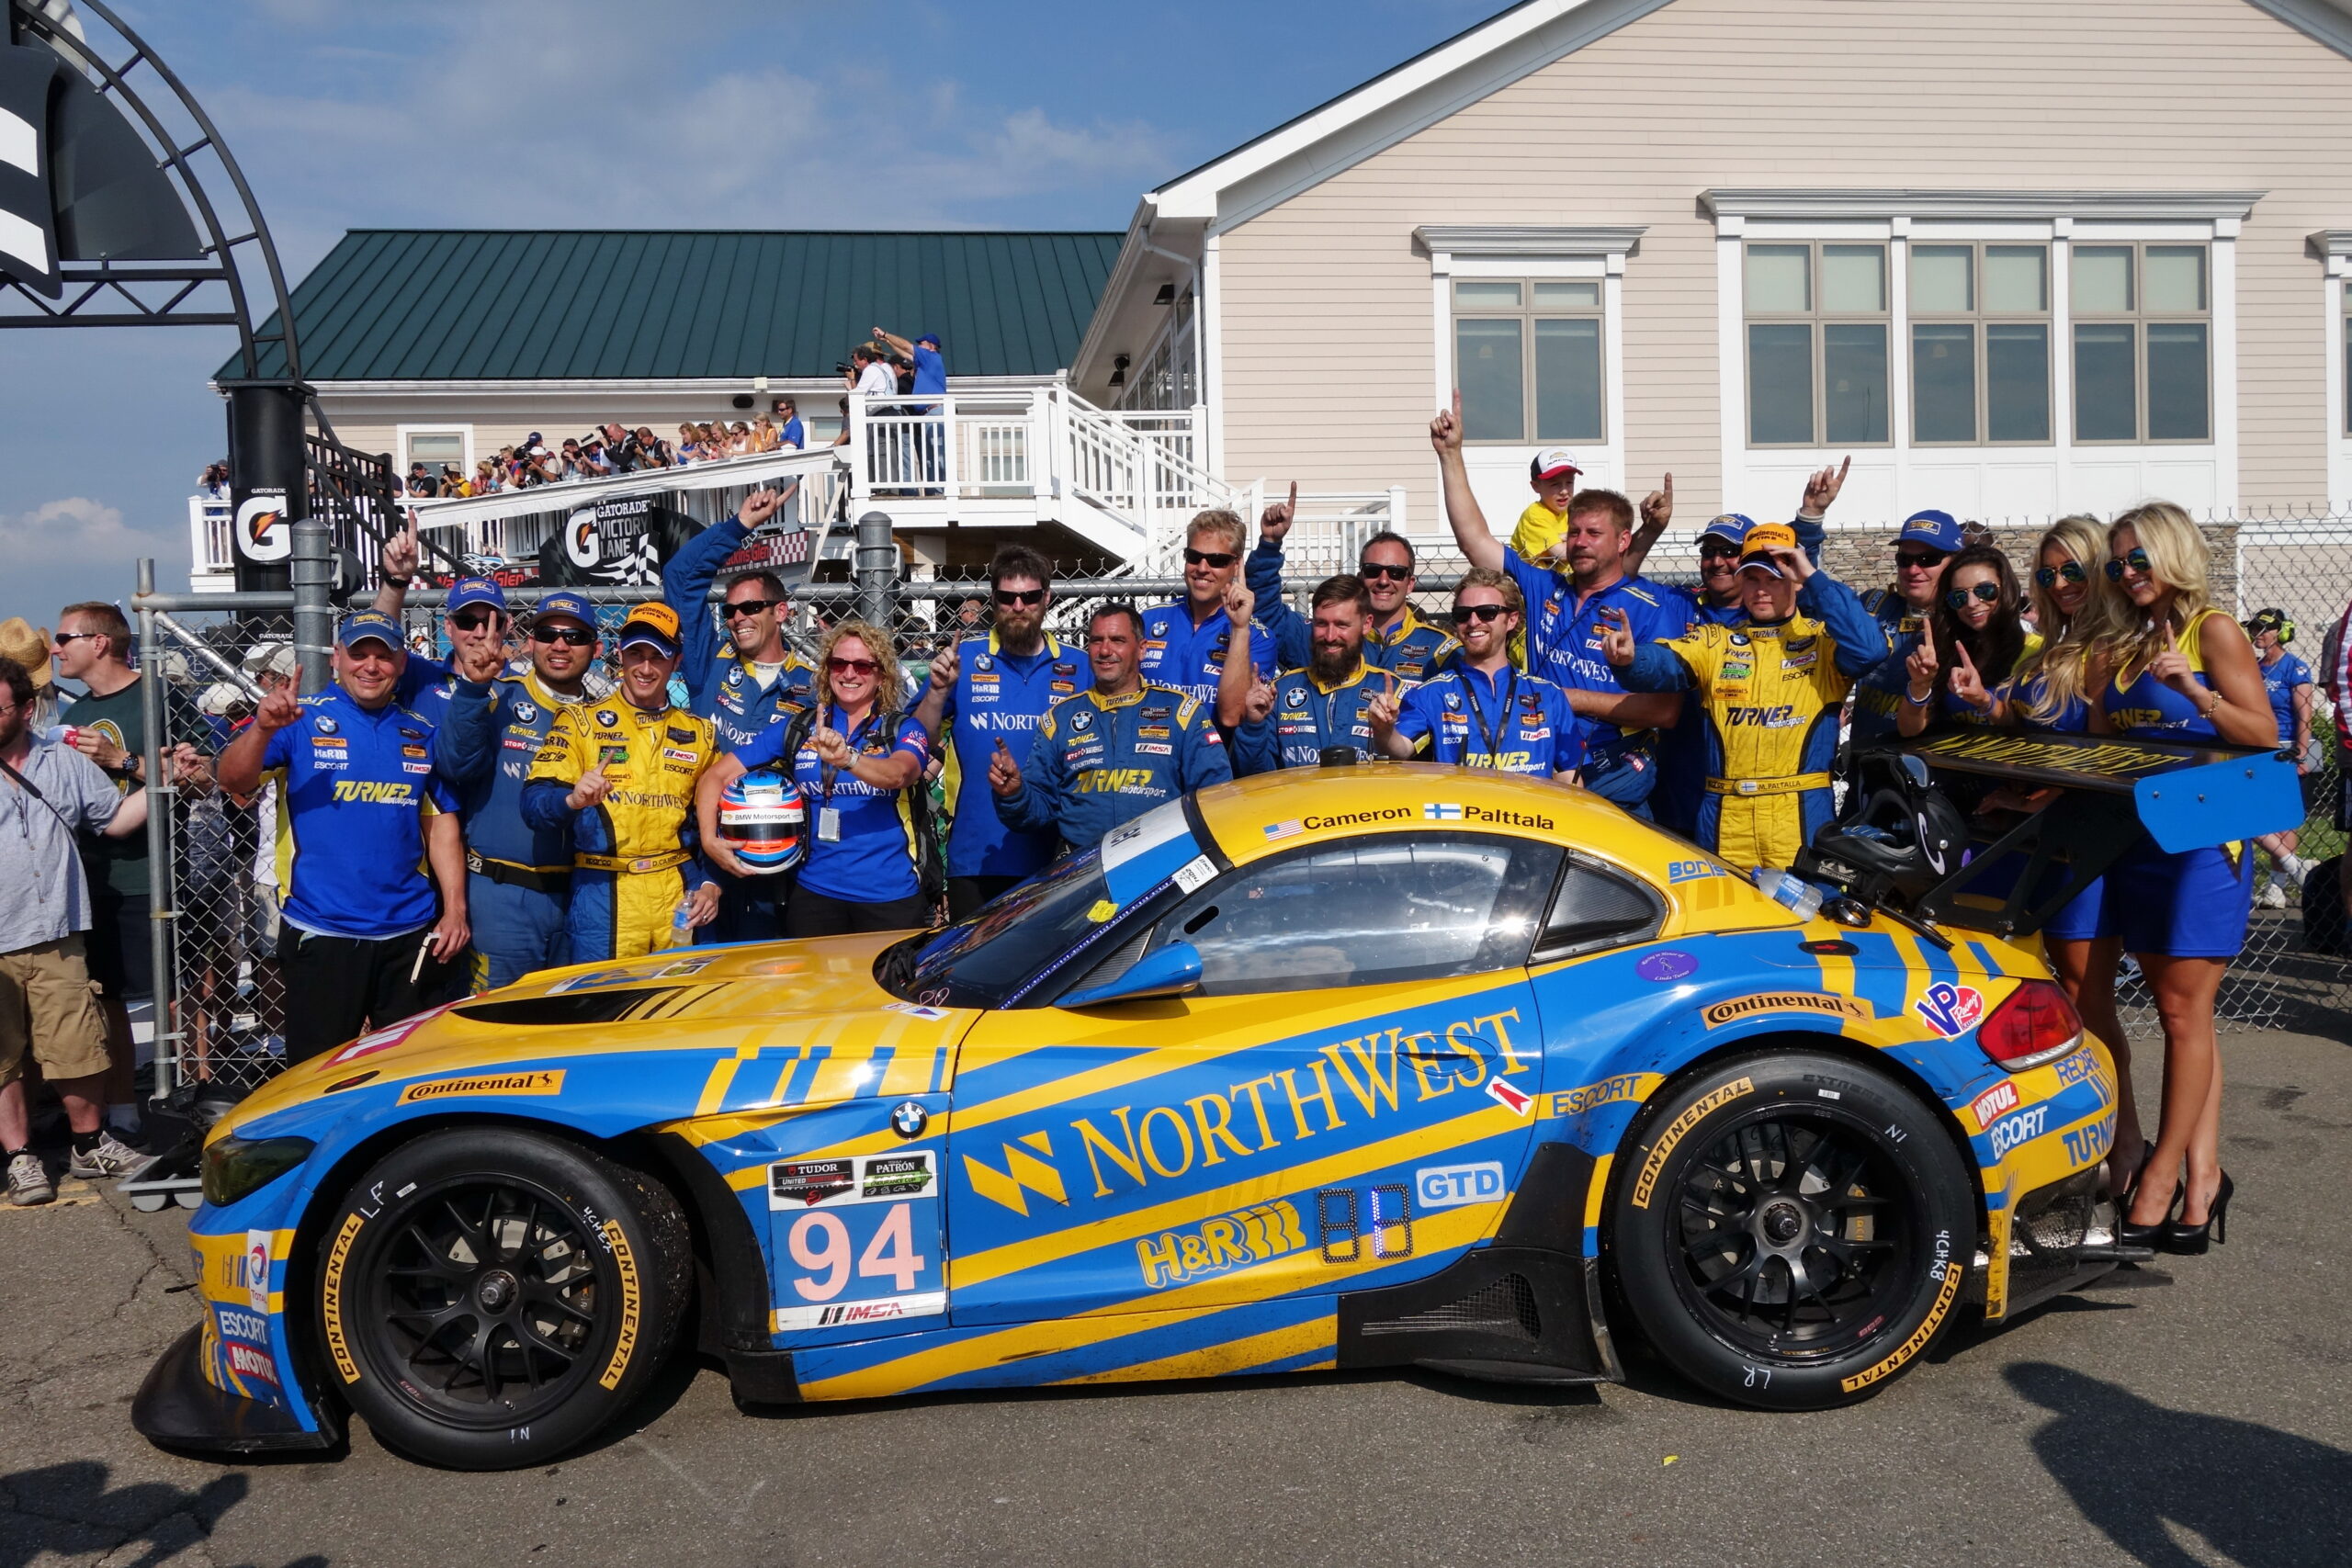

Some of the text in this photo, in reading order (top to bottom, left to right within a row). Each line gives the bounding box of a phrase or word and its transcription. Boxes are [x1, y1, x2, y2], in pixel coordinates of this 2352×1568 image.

[597, 502, 647, 518] GATORADE
[598, 517, 649, 537] VICTORY
[1747, 530, 1782, 542] Continental
[600, 537, 631, 558] LANE
[752, 543, 771, 560] Glen
[494, 571, 525, 588] Glen
[632, 605, 669, 622] Continental
[1782, 668, 1816, 682] ESCORT
[1105, 694, 1134, 705] TURNER
[1280, 711, 1308, 721] TURNER
[1724, 705, 1793, 727] TURNER
[1765, 716, 1807, 728] motorsport
[509, 725, 537, 737] TURNER
[594, 731, 624, 740] TURNER
[1067, 732, 1096, 746] TURNER
[673, 751, 695, 761] IMSA
[1148, 745, 1169, 753] IMSA
[314, 761, 349, 771] ESCORT
[663, 764, 695, 776] ESCORT
[1073, 768, 1154, 794] TURNER
[332, 780, 413, 803] TURNER
[623, 791, 684, 810] NORTHWES
[1118, 785, 1167, 798] motorsport
[753, 812, 791, 821] Motorsport
[1303, 805, 1412, 830] Cameron
[1464, 806, 1555, 830] Palttala
[1672, 970, 1690, 978] Turner
[1707, 994, 1844, 1024] Continental
[1917, 983, 1961, 1036] VP
[1954, 992, 1979, 1025] Racing
[407, 1074, 533, 1100] Continental
[1553, 1075, 1642, 1118] ESCORT
[1070, 1007, 1531, 1198] NORTHWEST
[1975, 1084, 2018, 1126] MOTUL
[1636, 1081, 1749, 1203] CONTINENTAL
[1990, 1105, 2048, 1161] ESCORT
[797, 1163, 838, 1175] TUDOR
[876, 1161, 915, 1173] PATRÓN
[1420, 1168, 1501, 1201] GTD
[360, 1179, 384, 1219] LF
[788, 1203, 924, 1301] 94
[1136, 1217, 1254, 1289] H&R
[326, 1220, 359, 1377] CONTINENTAL
[604, 1226, 638, 1382] CONTINENTAL
[844, 1302, 903, 1322] IMSA
[220, 1311, 268, 1346] ESCORT
[1846, 1267, 1961, 1388] CONTINENTAL
[232, 1346, 279, 1386] MOTUL
